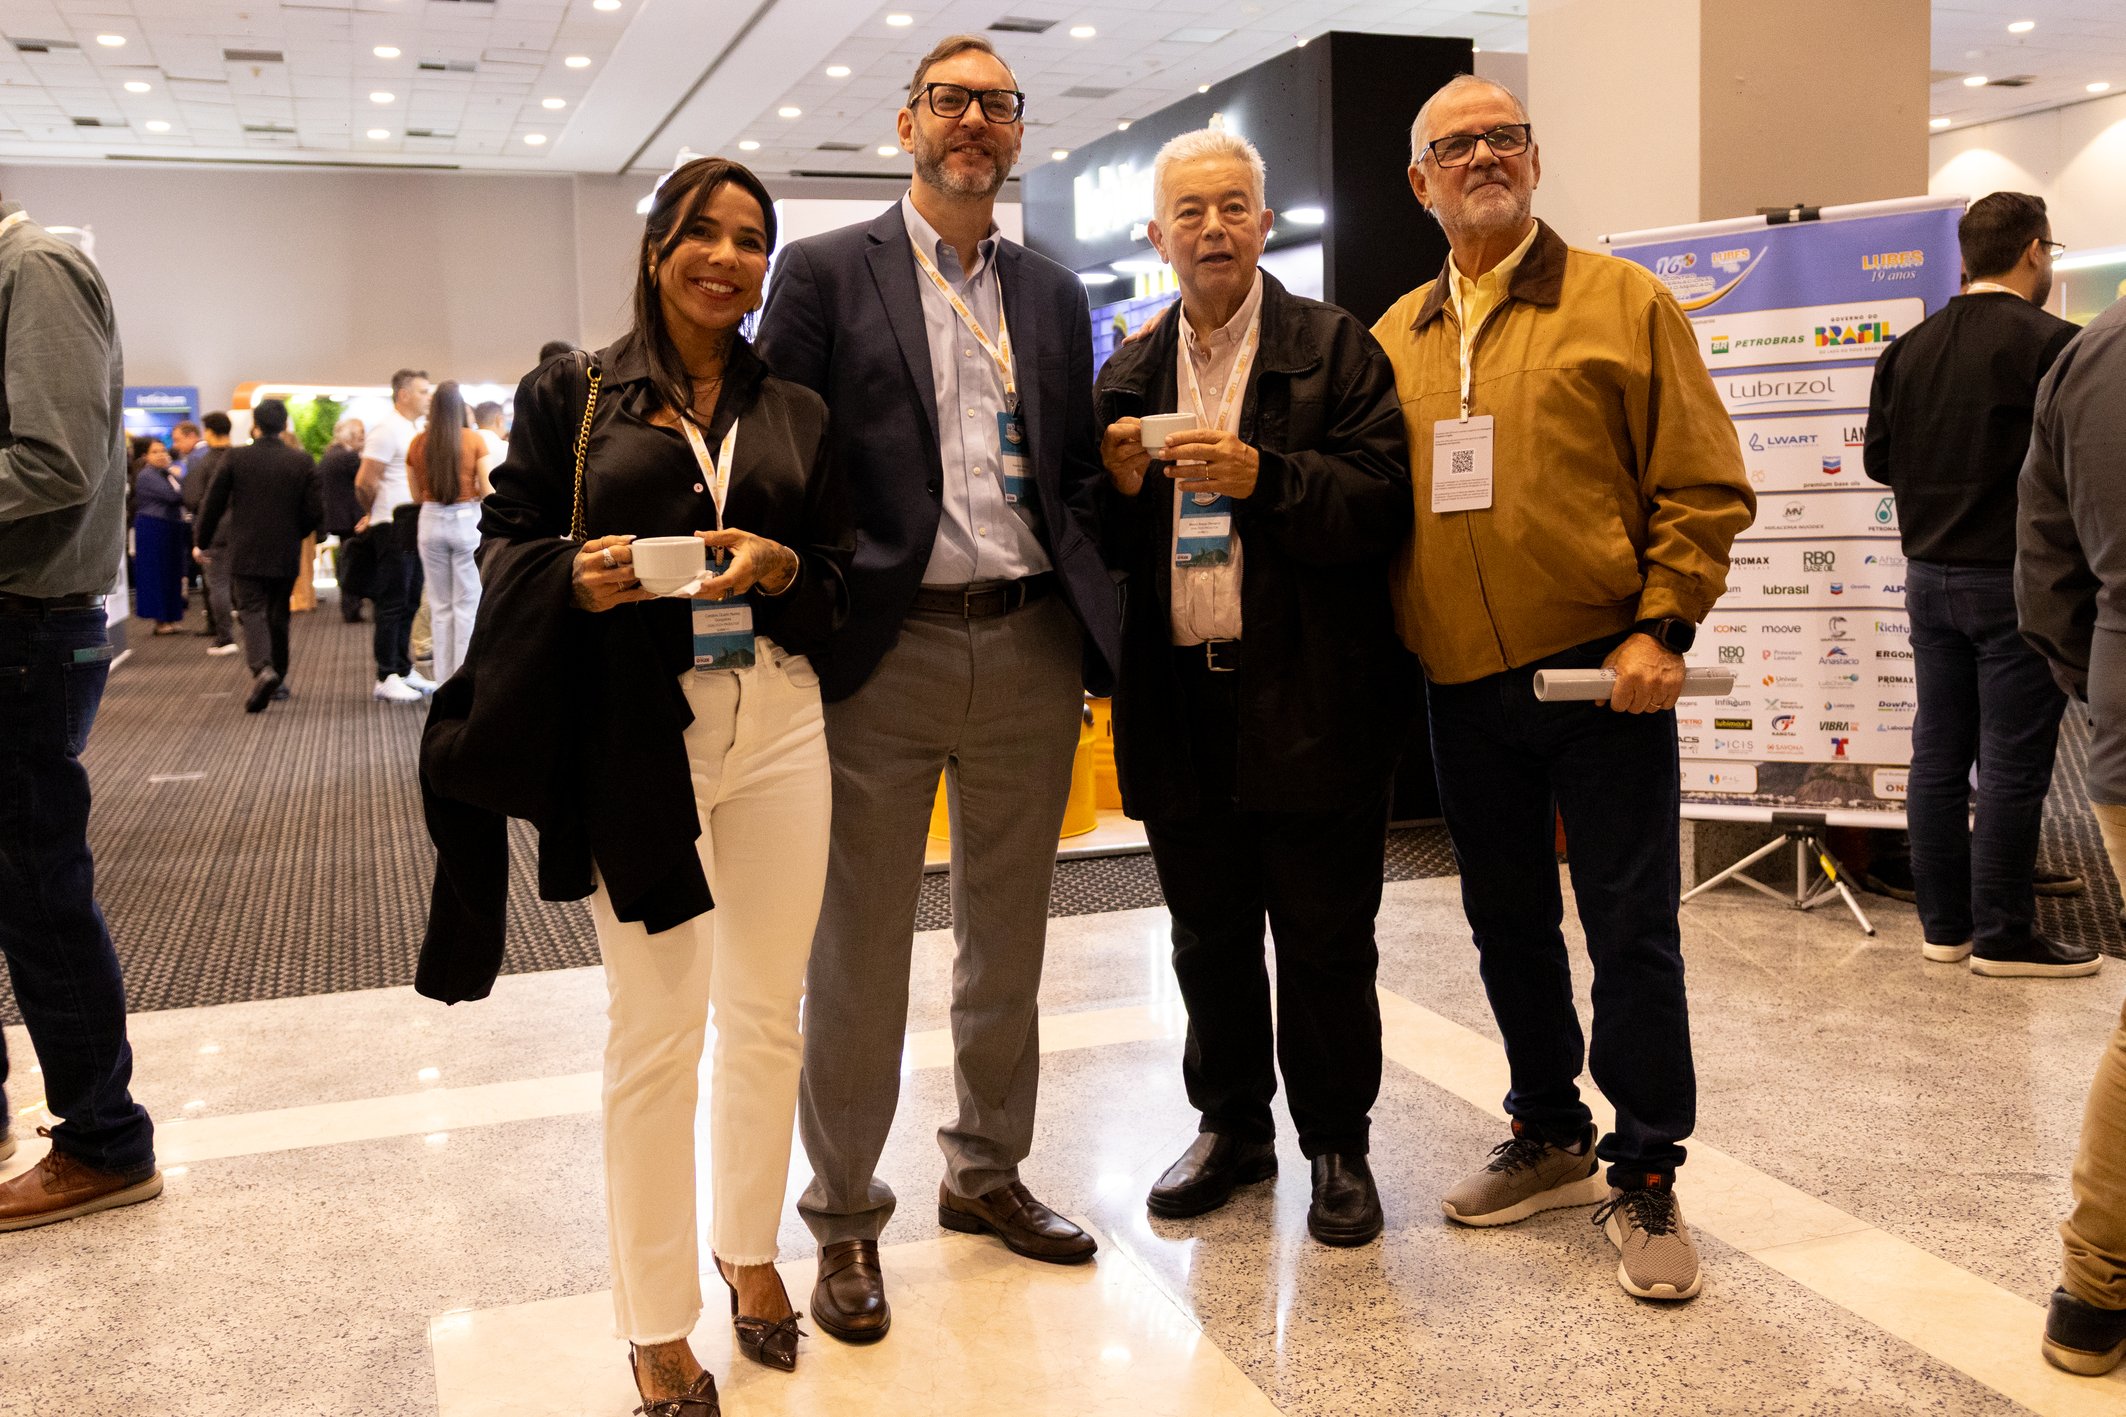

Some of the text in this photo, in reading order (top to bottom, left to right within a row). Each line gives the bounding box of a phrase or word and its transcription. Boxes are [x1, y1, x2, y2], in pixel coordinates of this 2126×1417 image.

[1862, 250, 1924, 270] LUBES
[1871, 270, 1917, 282] 19 anos
[1830, 314, 1864, 323] GOVERNO
[1814, 321, 1897, 347] BRASIL
[1734, 335, 1805, 348] PETROBRAS
[1729, 376, 1835, 399] Lubrizol
[1767, 434, 1818, 445] LWART
[1803, 481, 1833, 489] premium
[1730, 556, 1770, 566] PROMAX
[1763, 585, 1809, 595] lubrasil
[1761, 625, 1802, 633] moove
[1875, 650, 1913, 659] ERGON
[1818, 657, 1860, 665] Anastacio
[1878, 675, 1914, 684] PROMAX
[1820, 721, 1849, 731] VIBRA
[1727, 740, 1754, 749] ICIS
